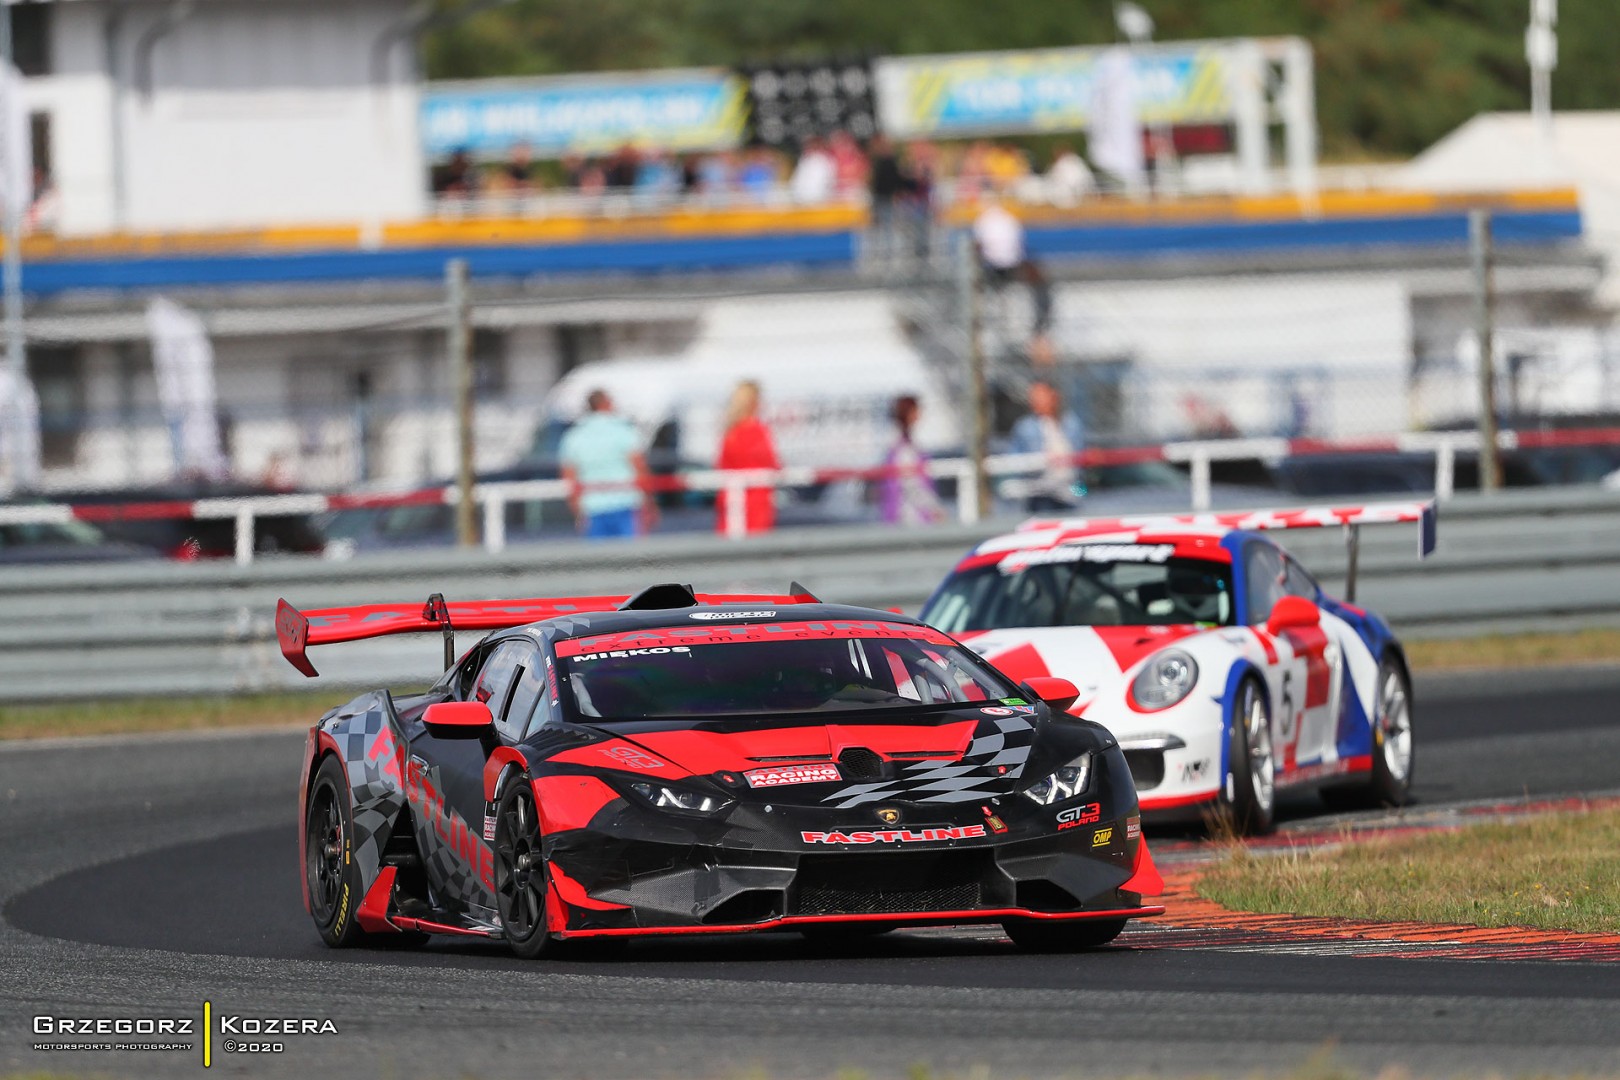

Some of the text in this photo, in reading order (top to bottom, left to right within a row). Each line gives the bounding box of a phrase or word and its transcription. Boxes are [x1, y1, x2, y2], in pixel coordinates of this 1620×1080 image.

[579, 622, 926, 647] FASTLINE
[581, 633, 760, 652] extreme
[573, 646, 691, 662] MIĘKOS
[1281, 670, 1293, 736] 5
[750, 769, 837, 781] RACING
[754, 774, 838, 786] ACADEMY
[368, 725, 496, 894] FASTLINE
[1056, 802, 1101, 823] GT3
[1057, 815, 1100, 831] POLAND
[801, 824, 987, 845] FASTLINE
[1093, 830, 1112, 845] OMP
[334, 883, 350, 936] PIRELLI
